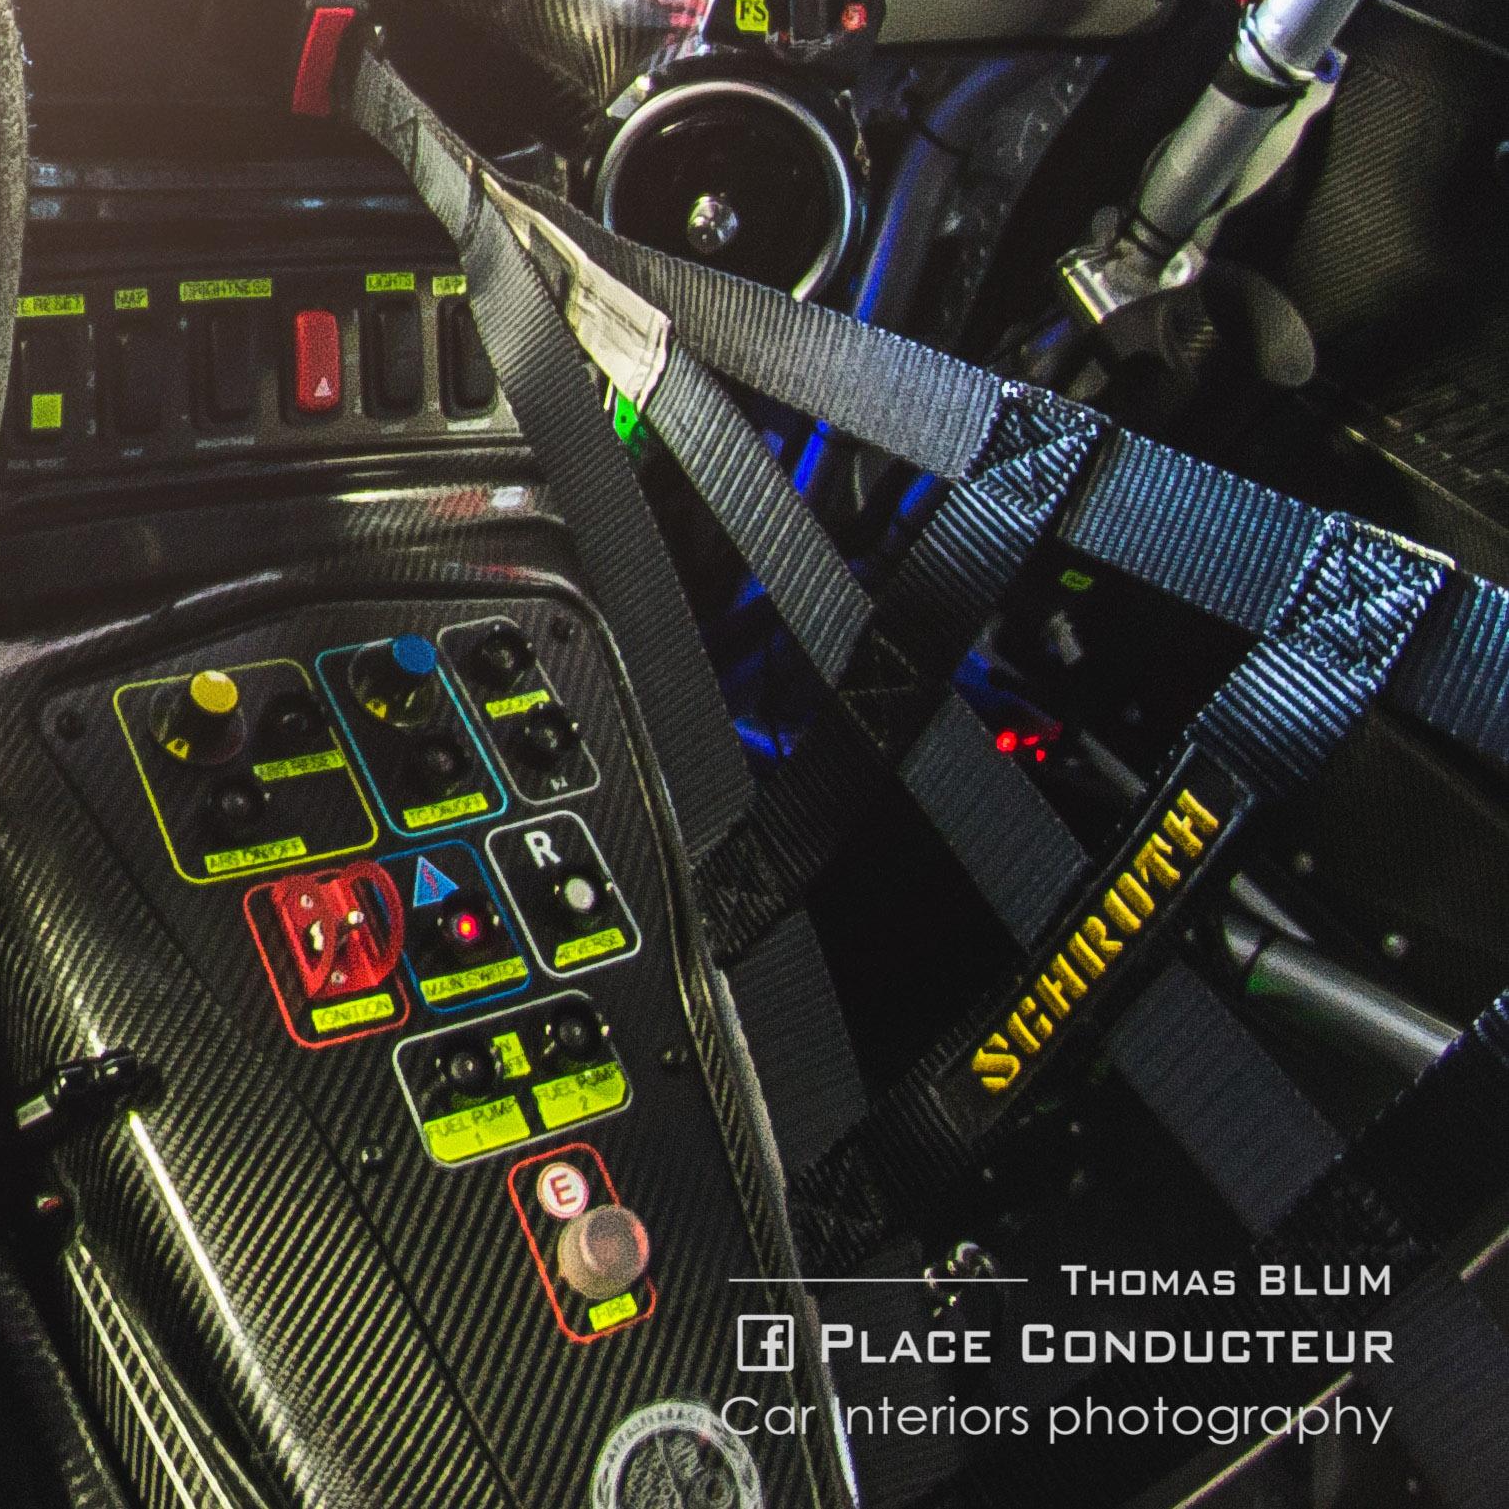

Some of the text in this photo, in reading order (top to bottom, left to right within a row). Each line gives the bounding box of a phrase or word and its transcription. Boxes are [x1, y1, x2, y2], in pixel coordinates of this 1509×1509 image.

[740, 0, 766, 22] FS
[524, 830, 561, 868] R
[971, 788, 1220, 1093] SCHROTH
[316, 998, 391, 1029] IGNITION
[426, 1098, 517, 1141] FUEL PUMP
[549, 1173, 578, 1206] E
[594, 1295, 636, 1323] FIRE
